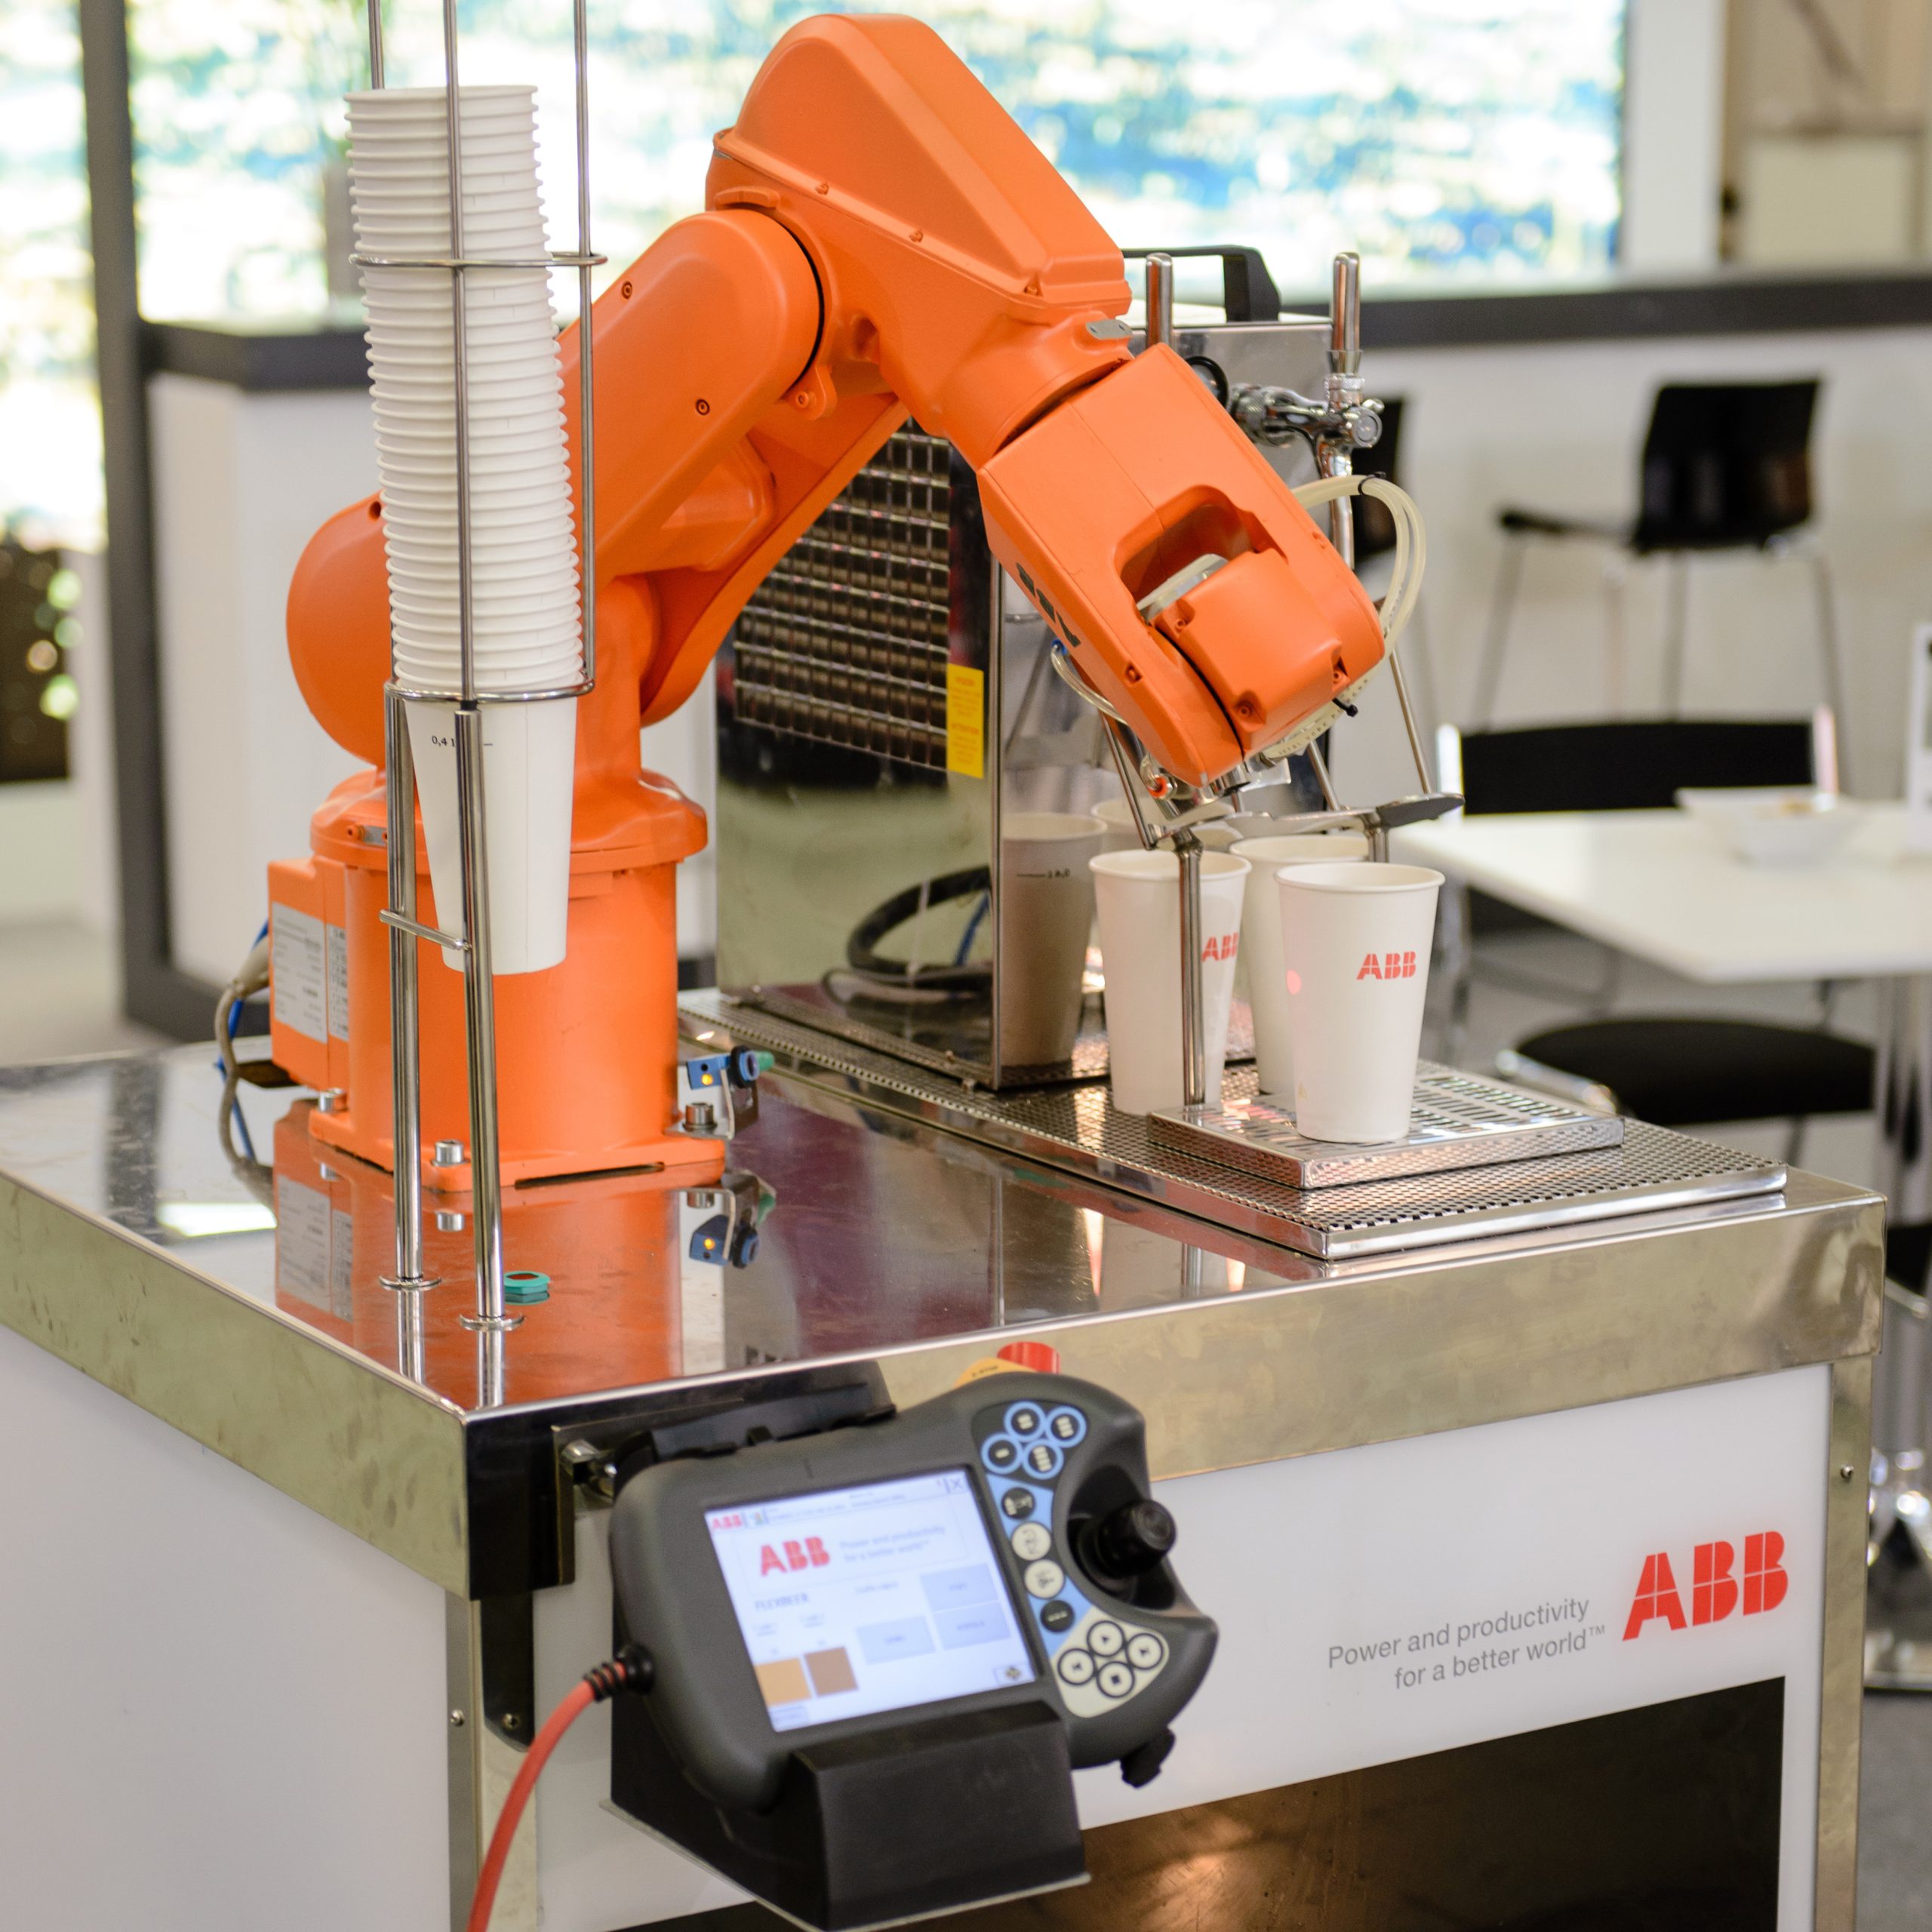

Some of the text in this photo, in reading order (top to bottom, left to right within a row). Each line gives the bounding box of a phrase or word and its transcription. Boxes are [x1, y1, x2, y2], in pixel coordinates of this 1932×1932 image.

[431, 735, 448, 746] 0,4
[1356, 950, 1417, 980] ABB
[712, 1513, 743, 1531] ABB
[759, 1535, 831, 1577] ABB
[1622, 1531, 1789, 1641] ABB
[1328, 1598, 1589, 1669] Power and productivity
[1394, 1665, 1426, 1690] for
[1432, 1663, 1446, 1682] a
[1453, 1647, 1520, 1678] better
